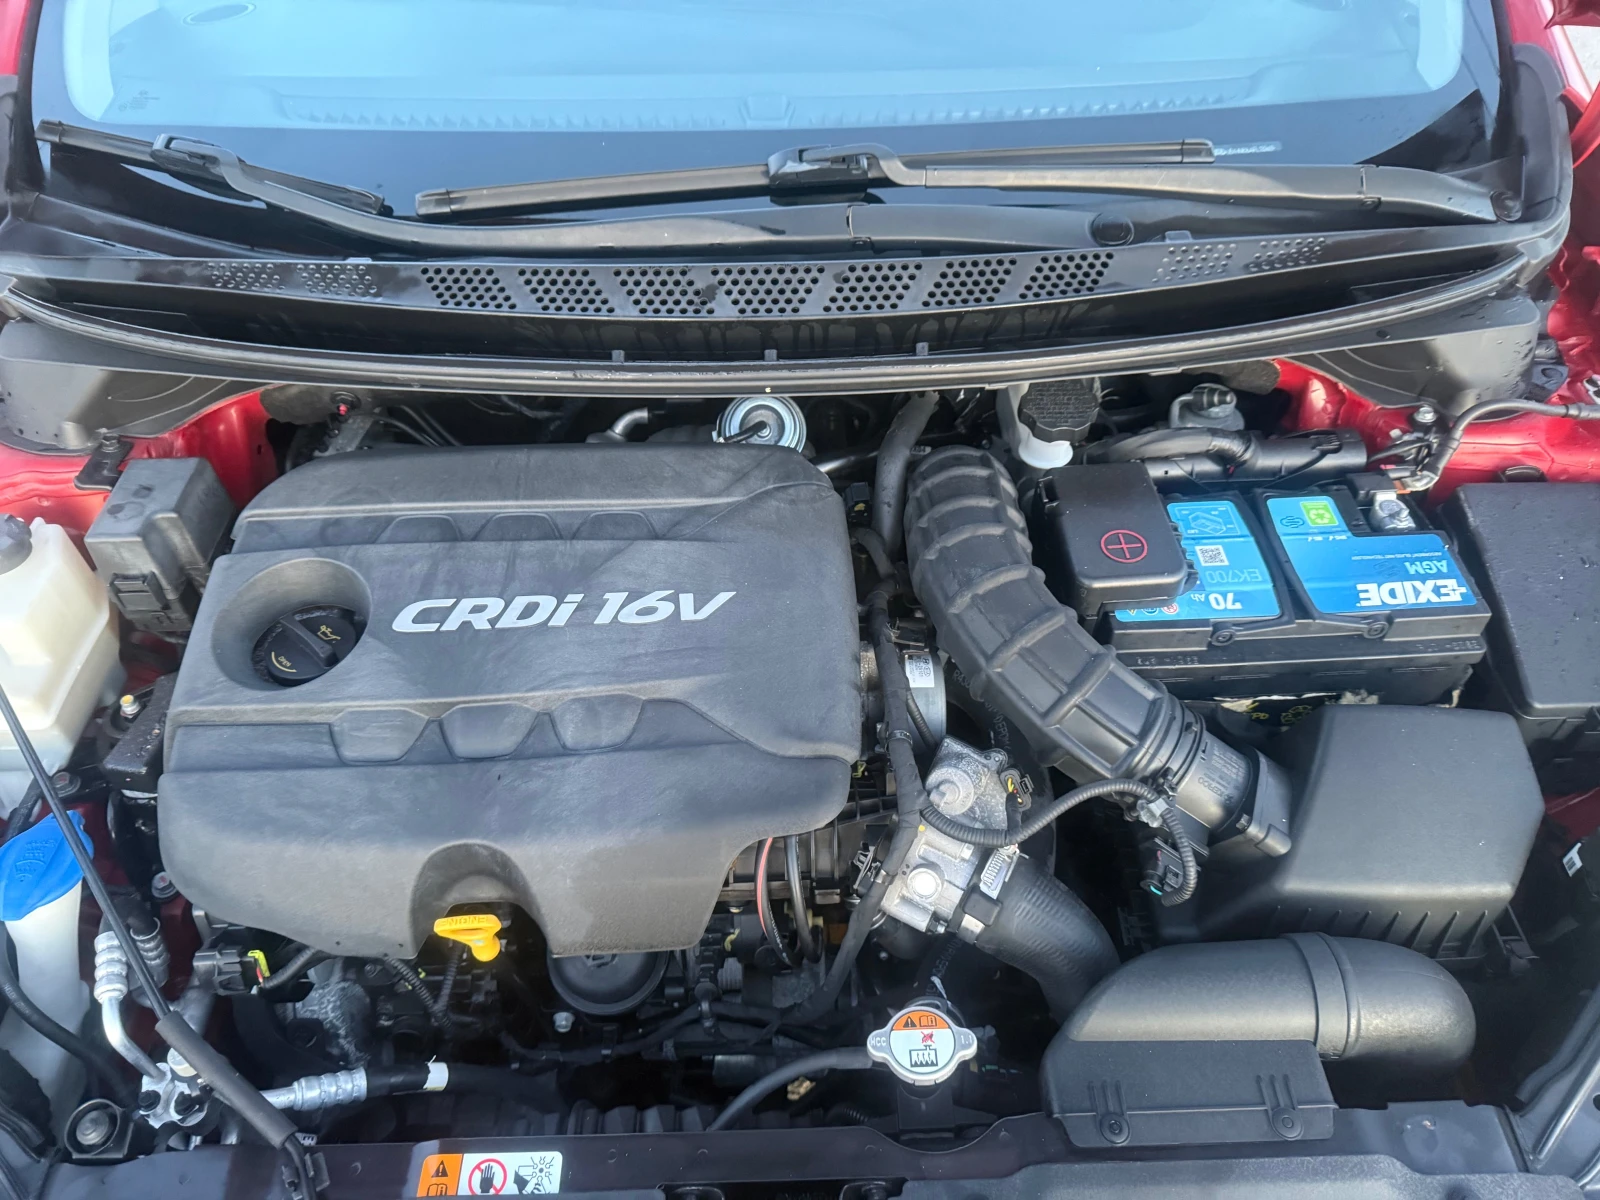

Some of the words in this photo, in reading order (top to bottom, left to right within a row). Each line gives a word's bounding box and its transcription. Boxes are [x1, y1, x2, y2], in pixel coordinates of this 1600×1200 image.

[1404, 559, 1448, 575] AGM
[1205, 568, 1263, 584] EK700
[1190, 593, 1206, 602] Ah
[1356, 579, 1467, 606] EXIDE
[1208, 592, 1243, 610] 70
[392, 594, 581, 633] CRDi
[593, 590, 737, 626] 16V
[277, 655, 292, 667] OPEN
[870, 1037, 887, 1047] HCC
[960, 1035, 972, 1045] 1.1
